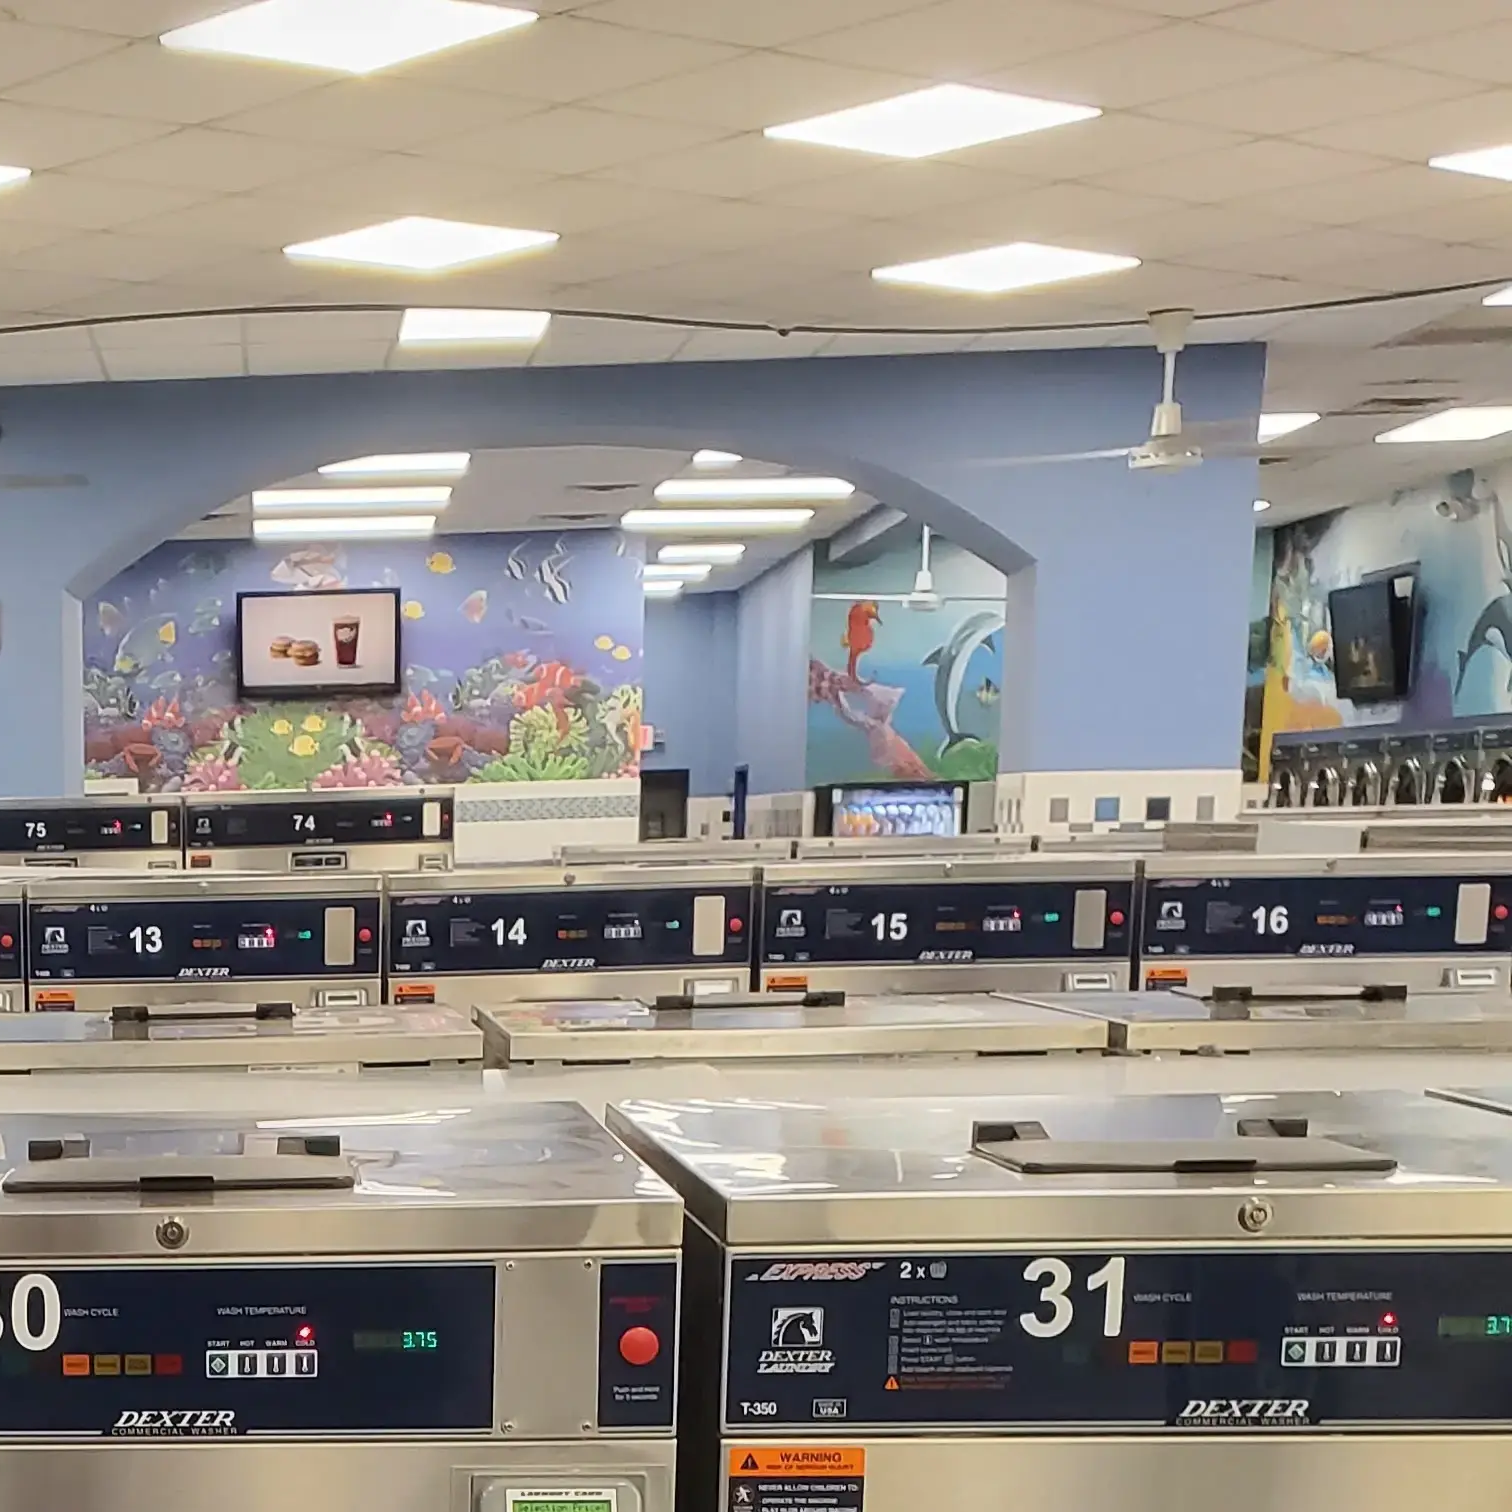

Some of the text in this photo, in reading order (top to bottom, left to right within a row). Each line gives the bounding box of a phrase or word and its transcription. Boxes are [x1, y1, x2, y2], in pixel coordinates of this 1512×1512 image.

[293, 814, 316, 831] 74
[25, 822, 47, 839] 75
[1251, 905, 1289, 935] 16
[491, 917, 527, 946] 14
[871, 912, 908, 941] 15
[129, 925, 163, 953] 13
[918, 950, 973, 960] DEXTER
[542, 958, 596, 968] DEXTER
[178, 967, 230, 977] DEXTER
[760, 1263, 868, 1280] EXPRESS
[900, 1262, 925, 1278] 2 x
[890, 1295, 958, 1304] INSTRUCTIONS
[1019, 1256, 1126, 1337] 31
[1133, 1293, 1192, 1302] WASH CYCLE
[1297, 1292, 1393, 1300] WASH TEMPERATURE
[64, 1309, 119, 1317] WASH CYCLE
[217, 1307, 306, 1315] WASH TEMPERATURE
[403, 1332, 437, 1348] 3.75
[758, 1351, 833, 1362] DEXTER
[756, 1362, 835, 1373] LAUNDRY
[740, 1402, 777, 1415] T-350
[1179, 1400, 1310, 1417] DEXTER
[114, 1411, 235, 1427] DEXTER
[1176, 1417, 1311, 1426] COMMERCIAL WASHER
[112, 1427, 237, 1435] COMMERCIAL WASHER
[780, 1452, 842, 1463] WARNING
[517, 1503, 567, 1512] Selection
